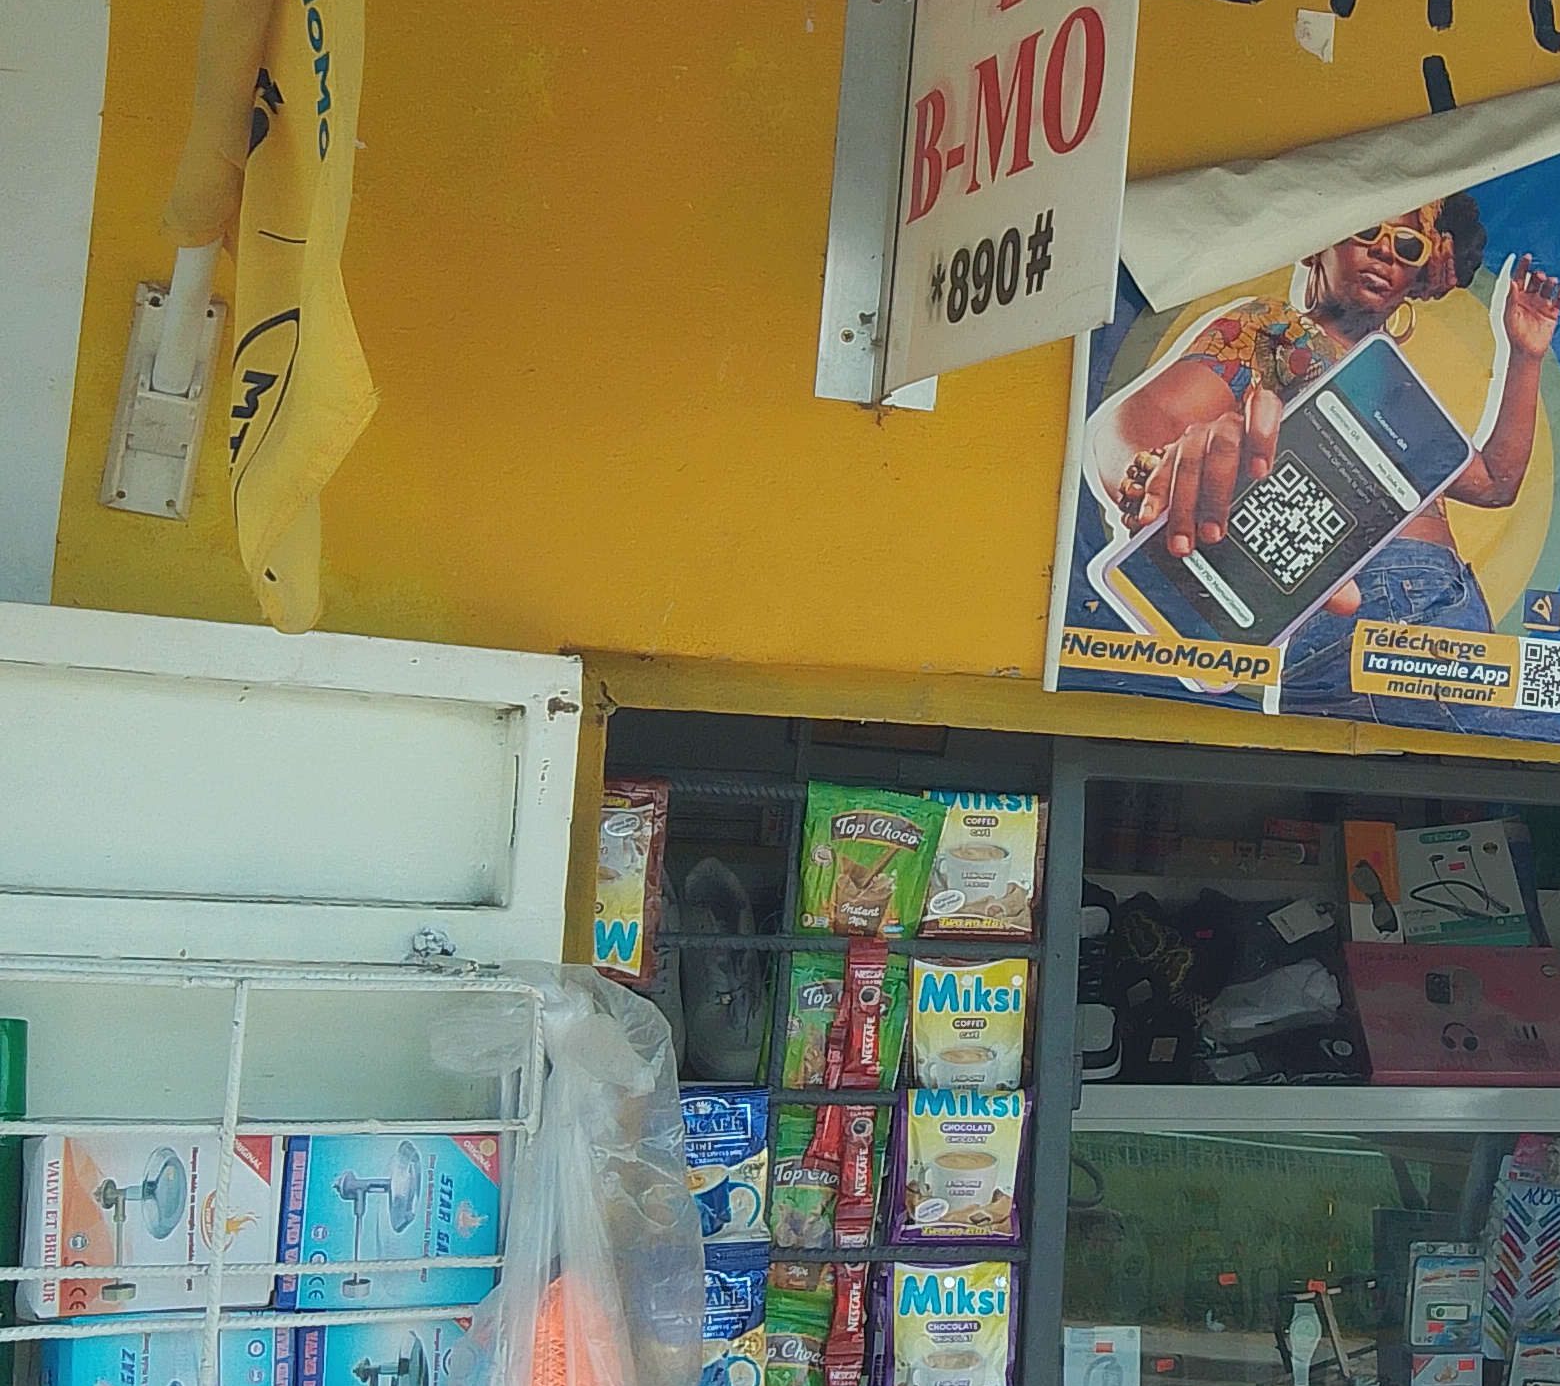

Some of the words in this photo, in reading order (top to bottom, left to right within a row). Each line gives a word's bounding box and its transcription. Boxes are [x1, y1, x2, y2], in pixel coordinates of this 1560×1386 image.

[905, 5, 1105, 225] B-MO
[1363, 627, 1487, 661] Télécharge
[1389, 655, 1467, 681] nouvelle
[1470, 664, 1509, 687] App
[1386, 677, 1497, 703] maintenant
[835, 816, 866, 838] Top
[869, 818, 920, 845] Choco
[840, 902, 881, 918] Instant
[803, 986, 833, 1011] Top
[919, 973, 1022, 1013] Miksi
[914, 1089, 1020, 1118] Miksi
[942, 1123, 993, 1133] CHOCOLATE
[463, 1140, 493, 1173] ORIGINAL
[46, 1160, 60, 1203] VALVE
[776, 1161, 802, 1185] Top
[437, 1173, 454, 1224] STAR
[44, 1210, 59, 1228] ET
[899, 1275, 1006, 1316] Miksi
[927, 1321, 979, 1332] CHOCOLATE
